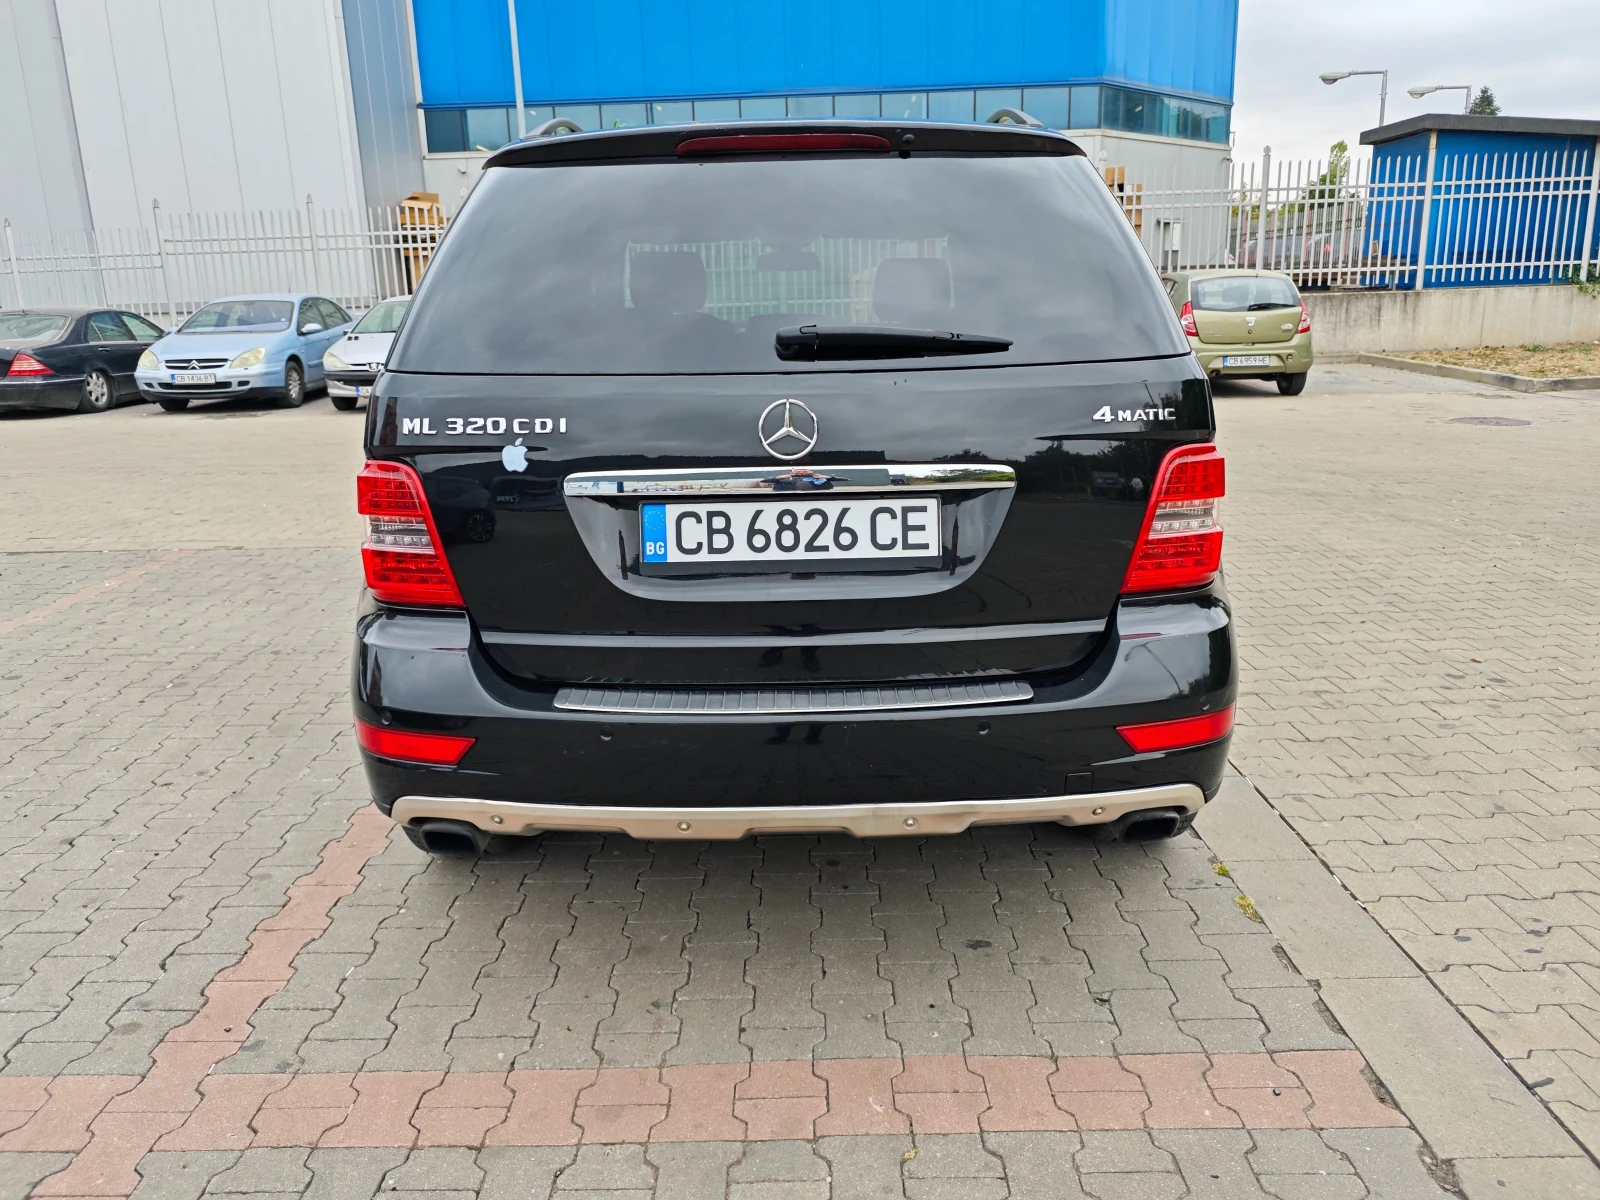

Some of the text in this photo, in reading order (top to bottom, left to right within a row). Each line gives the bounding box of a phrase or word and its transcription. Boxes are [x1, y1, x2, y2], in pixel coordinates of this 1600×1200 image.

[1228, 356, 1268, 365] CB 6959 HE
[402, 417, 438, 435] ML
[445, 417, 507, 435] 320
[675, 505, 930, 555] CB 6826 CE
[646, 541, 665, 556] BG
